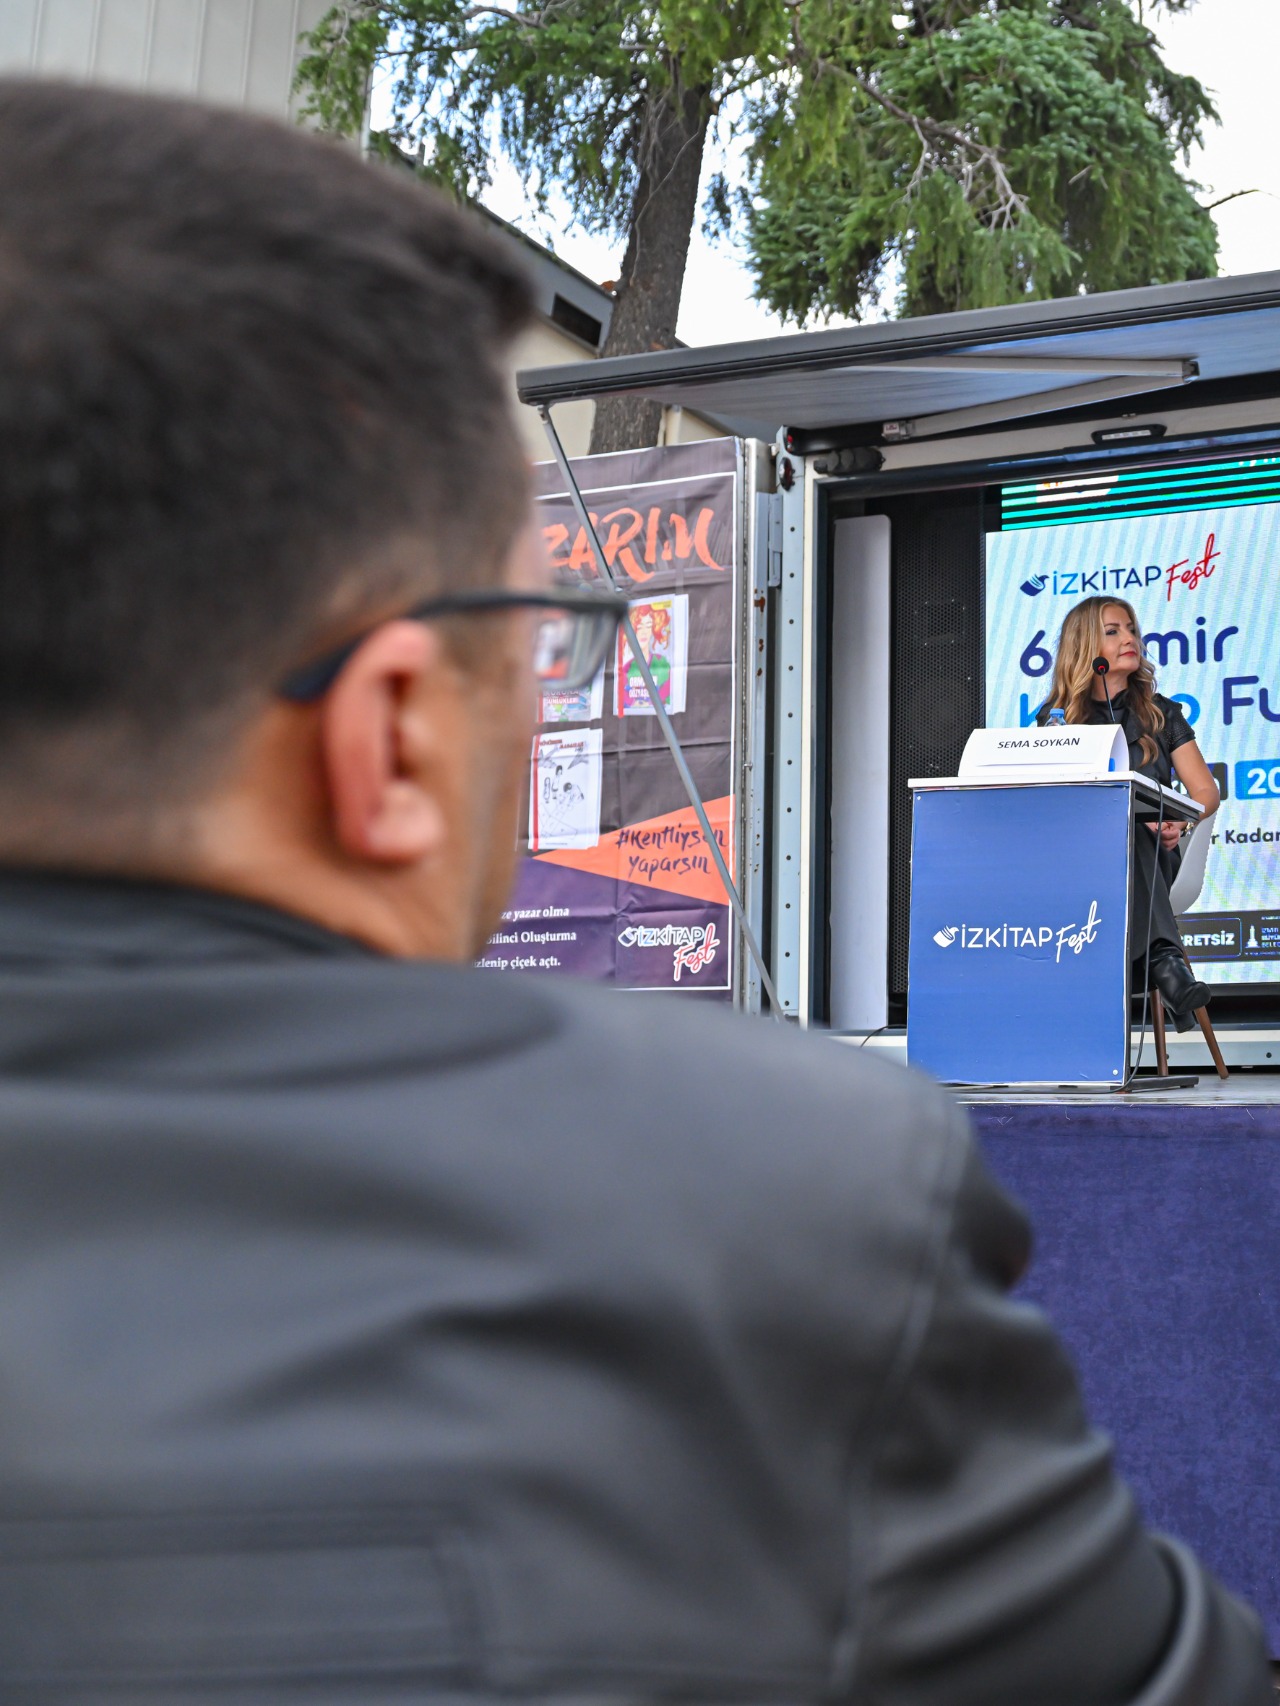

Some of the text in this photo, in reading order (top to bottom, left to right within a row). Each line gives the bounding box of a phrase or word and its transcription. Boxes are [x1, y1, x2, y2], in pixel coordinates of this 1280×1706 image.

[1053, 533, 1221, 601] İZKİTAP Fest
[1144, 616, 1239, 666] mir
[997, 737, 1081, 749] SEMA SOYKAN
[513, 909, 542, 922] yazar
[542, 906, 570, 917] olma
[487, 931, 577, 944] ilinci Oluşturma
[961, 900, 1102, 964] İZKİTAP Fest
[1182, 930, 1235, 947] RETSİZ
[639, 923, 720, 981] İZKİTAP Fest
[510, 956, 537, 969] çiçek
[538, 956, 561, 968] açtı.
